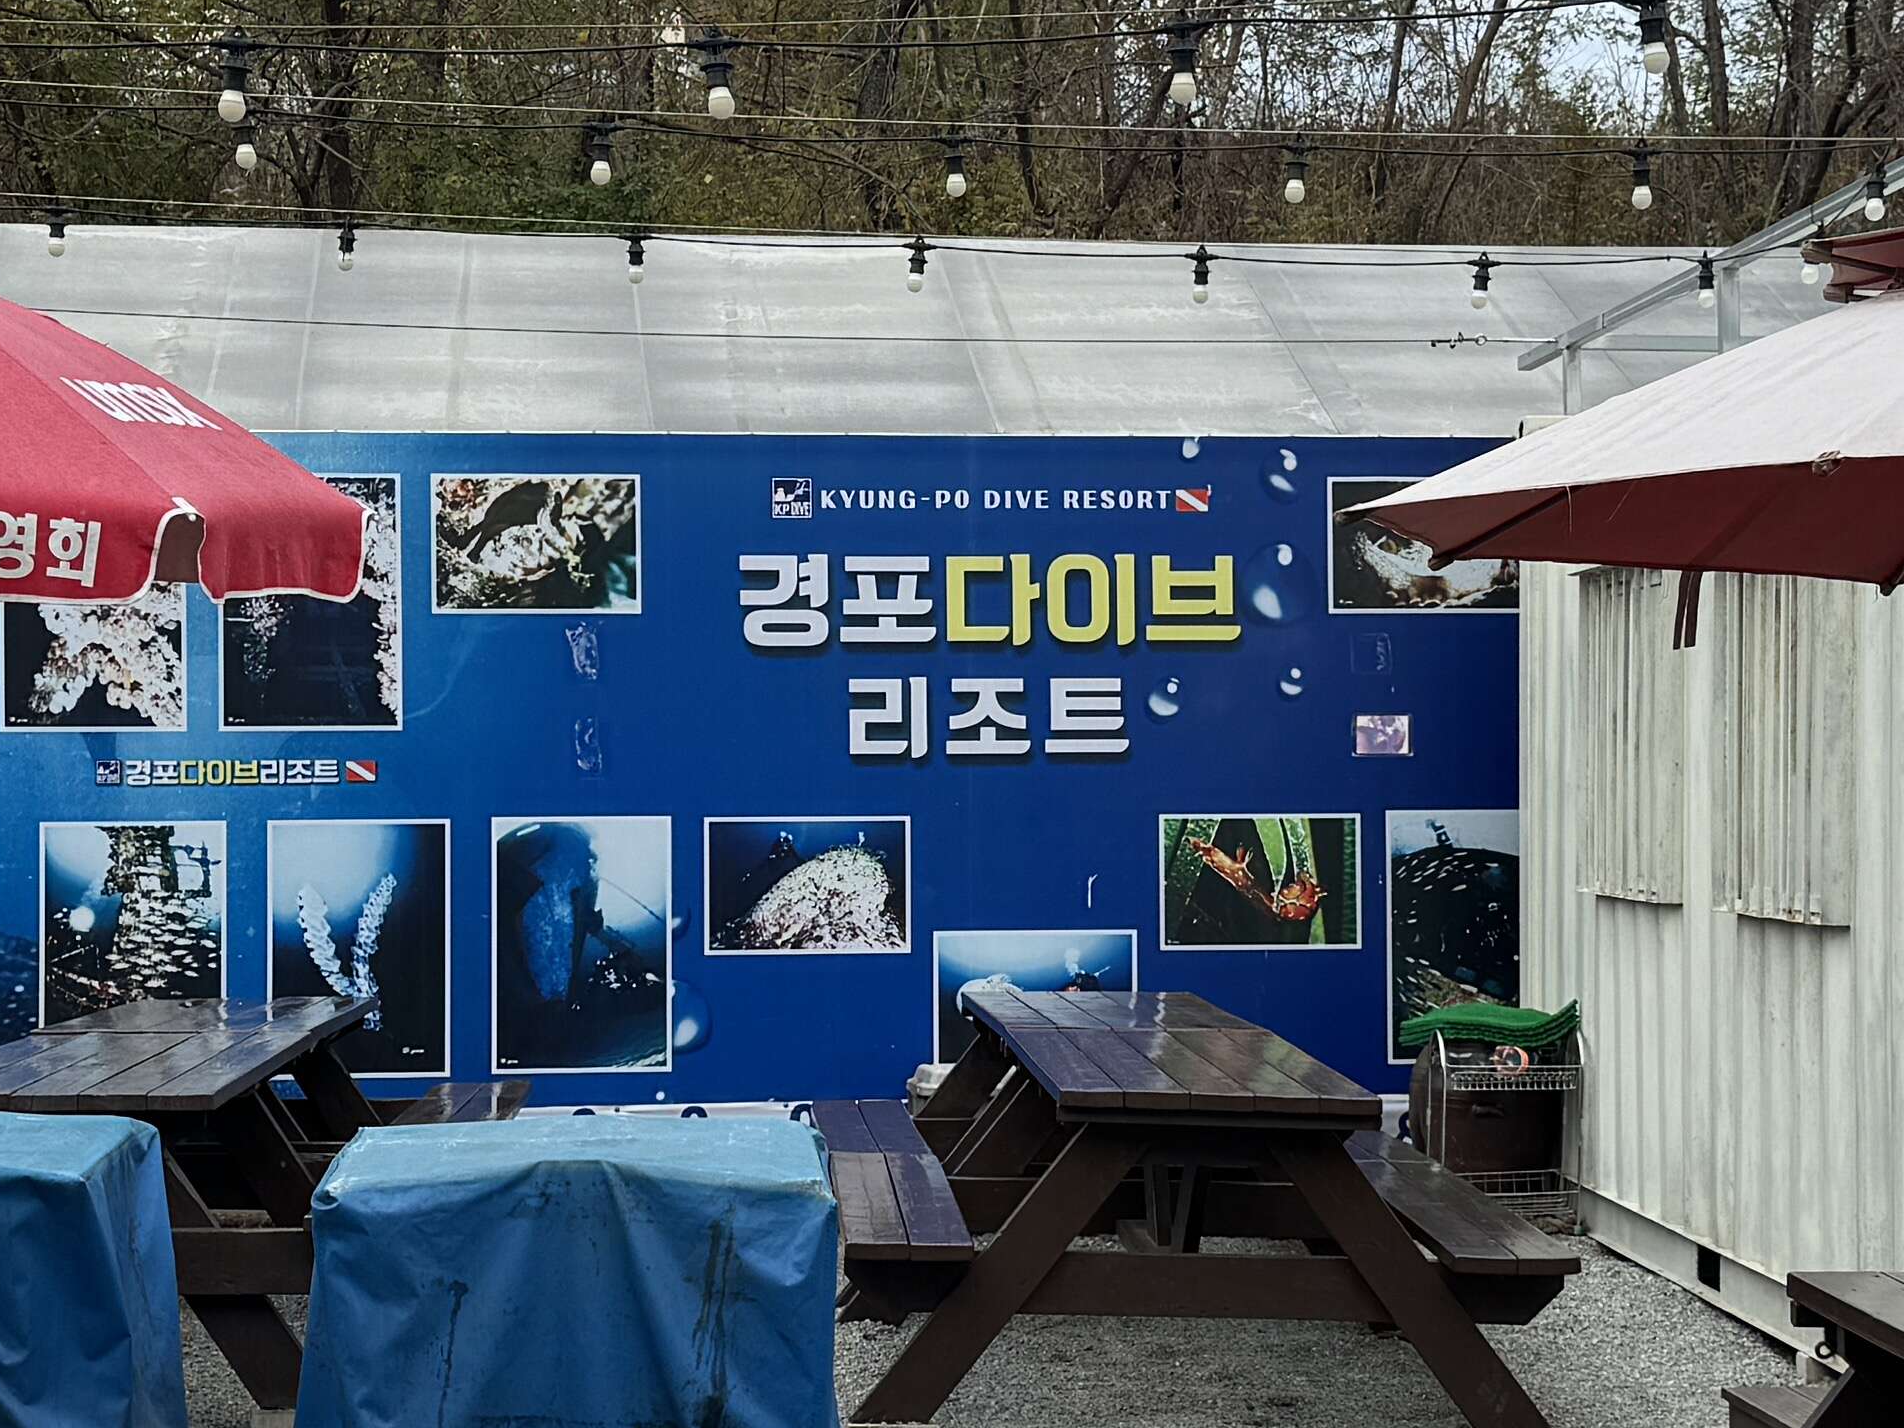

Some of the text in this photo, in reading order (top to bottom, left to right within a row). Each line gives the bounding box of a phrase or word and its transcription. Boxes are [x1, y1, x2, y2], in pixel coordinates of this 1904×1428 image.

[820, 489, 1172, 510] KYUNG-PO DIVE RESORT
[739, 553, 1242, 647] 경포다이브
[848, 675, 1130, 759] 리조트
[125, 759, 339, 786] 경포다이브리조트
